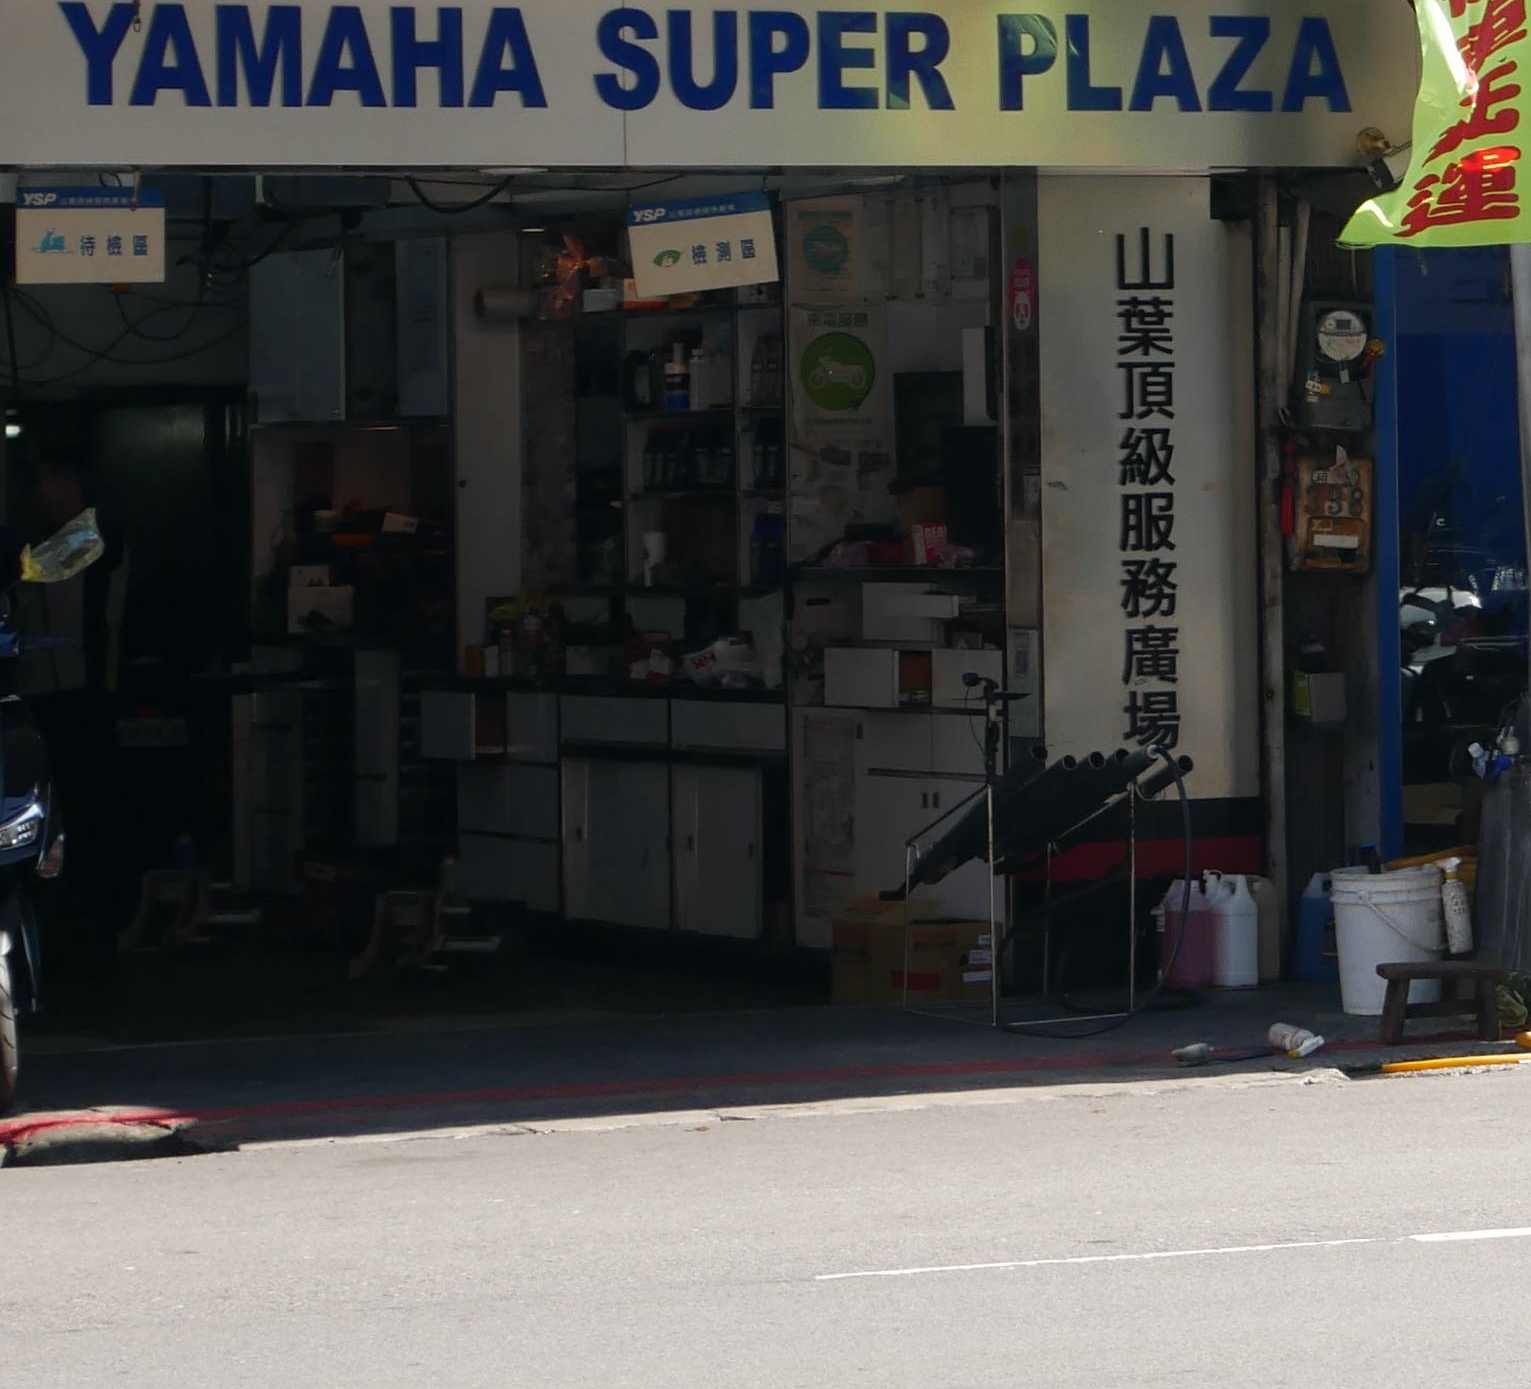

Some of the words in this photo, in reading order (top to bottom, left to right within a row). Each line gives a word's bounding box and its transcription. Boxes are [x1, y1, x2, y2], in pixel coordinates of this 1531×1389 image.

[58, 1, 548, 108] YAMAHA
[593, 8, 956, 111] SUPER
[997, 13, 1352, 113] PLAZA
[22, 192, 57, 206] YSP
[632, 206, 667, 223] YSP
[1117, 226, 1181, 752] 山葉頂級服務廣場
